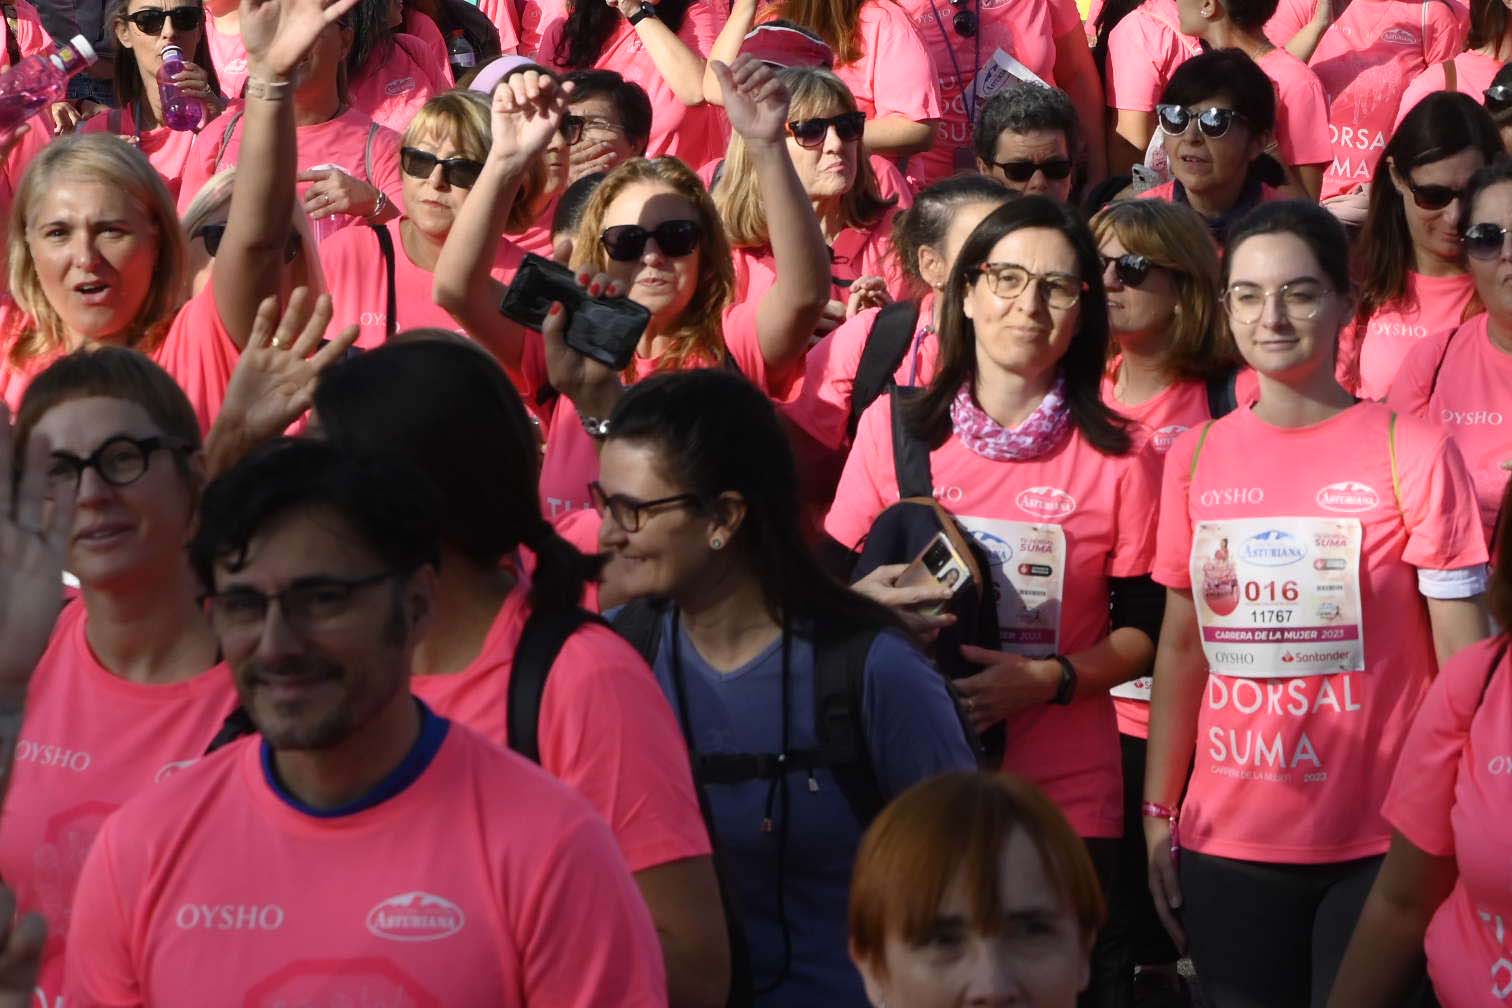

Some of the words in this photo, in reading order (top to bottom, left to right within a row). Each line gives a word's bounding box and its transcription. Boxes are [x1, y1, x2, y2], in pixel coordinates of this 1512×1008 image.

[1201, 487, 1264, 508] OYSHO
[1019, 543, 1053, 554] SUMA
[1244, 544, 1302, 558] ASTURIANA
[1244, 580, 1300, 602] 016
[1251, 610, 1293, 623] 11767
[1215, 630, 1252, 640] CARRERA
[1254, 631, 1268, 640] DE
[1269, 630, 1282, 640] LA
[1283, 630, 1318, 640] MUJER
[1215, 651, 1254, 665] OYSHO
[1295, 650, 1350, 663] Santander
[1209, 674, 1361, 716] DORSAL
[14, 740, 91, 773] OYSHO
[1208, 725, 1322, 769] SUMA
[175, 903, 285, 931] OYSHO
